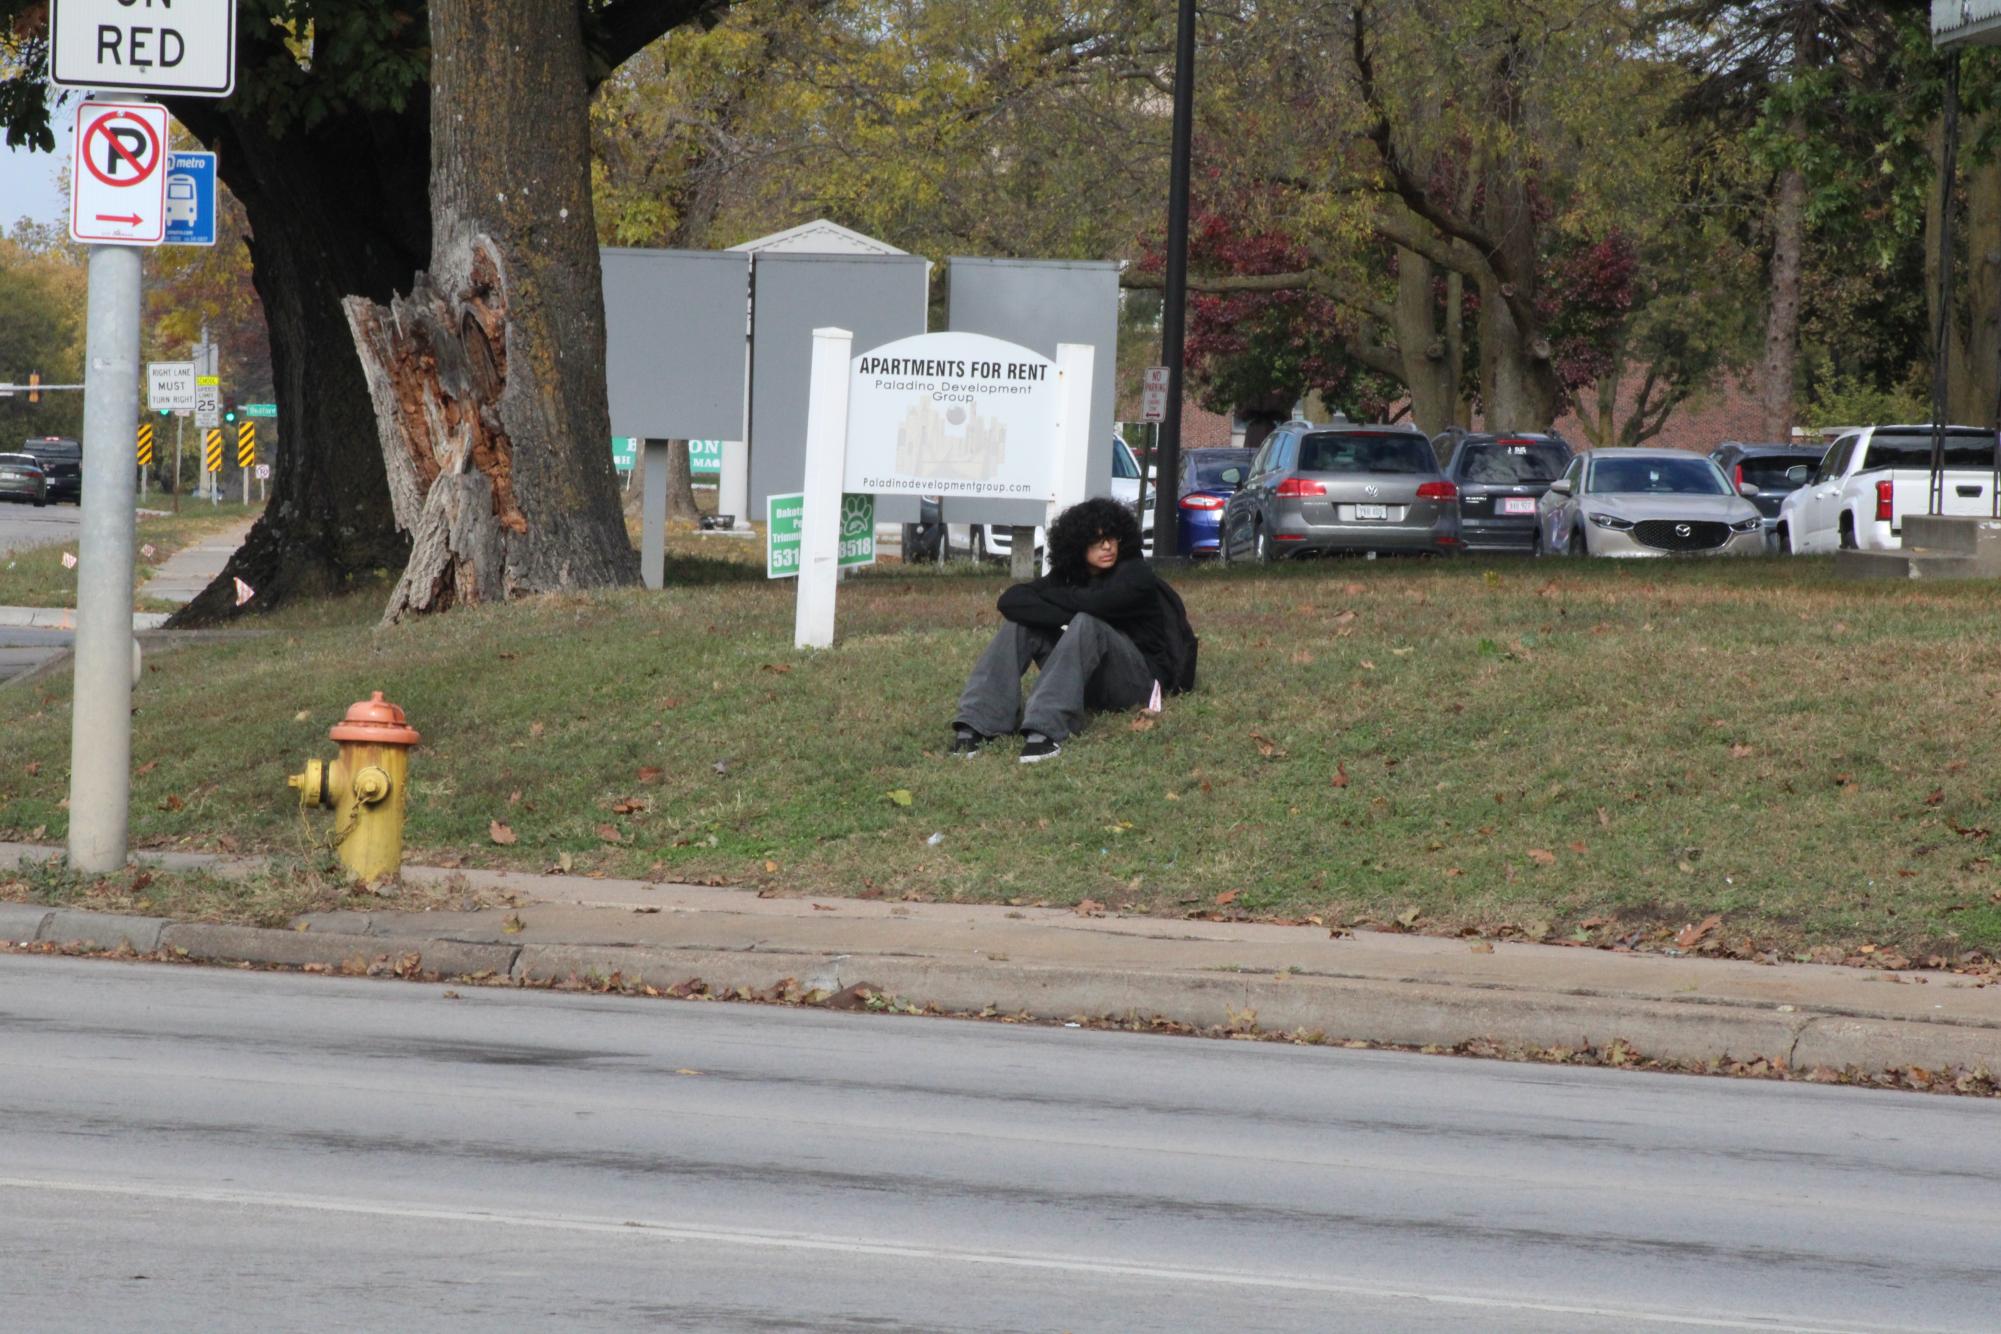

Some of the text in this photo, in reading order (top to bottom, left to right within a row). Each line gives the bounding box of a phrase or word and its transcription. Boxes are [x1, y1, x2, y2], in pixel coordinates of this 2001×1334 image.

[97, 24, 185, 68] RED
[176, 157, 206, 169] metro
[152, 368, 191, 377] RIGHT LANE
[860, 357, 1048, 381] APARTMENTS FOR RENT
[158, 381, 185, 391] MUST
[875, 379, 1032, 396] Paladino Development
[151, 396, 193, 404] TURN RIGHT
[932, 391, 974, 403] Group
[198, 400, 216, 412] 25
[863, 477, 1032, 493] Paladinodevelopmentgroup.com
